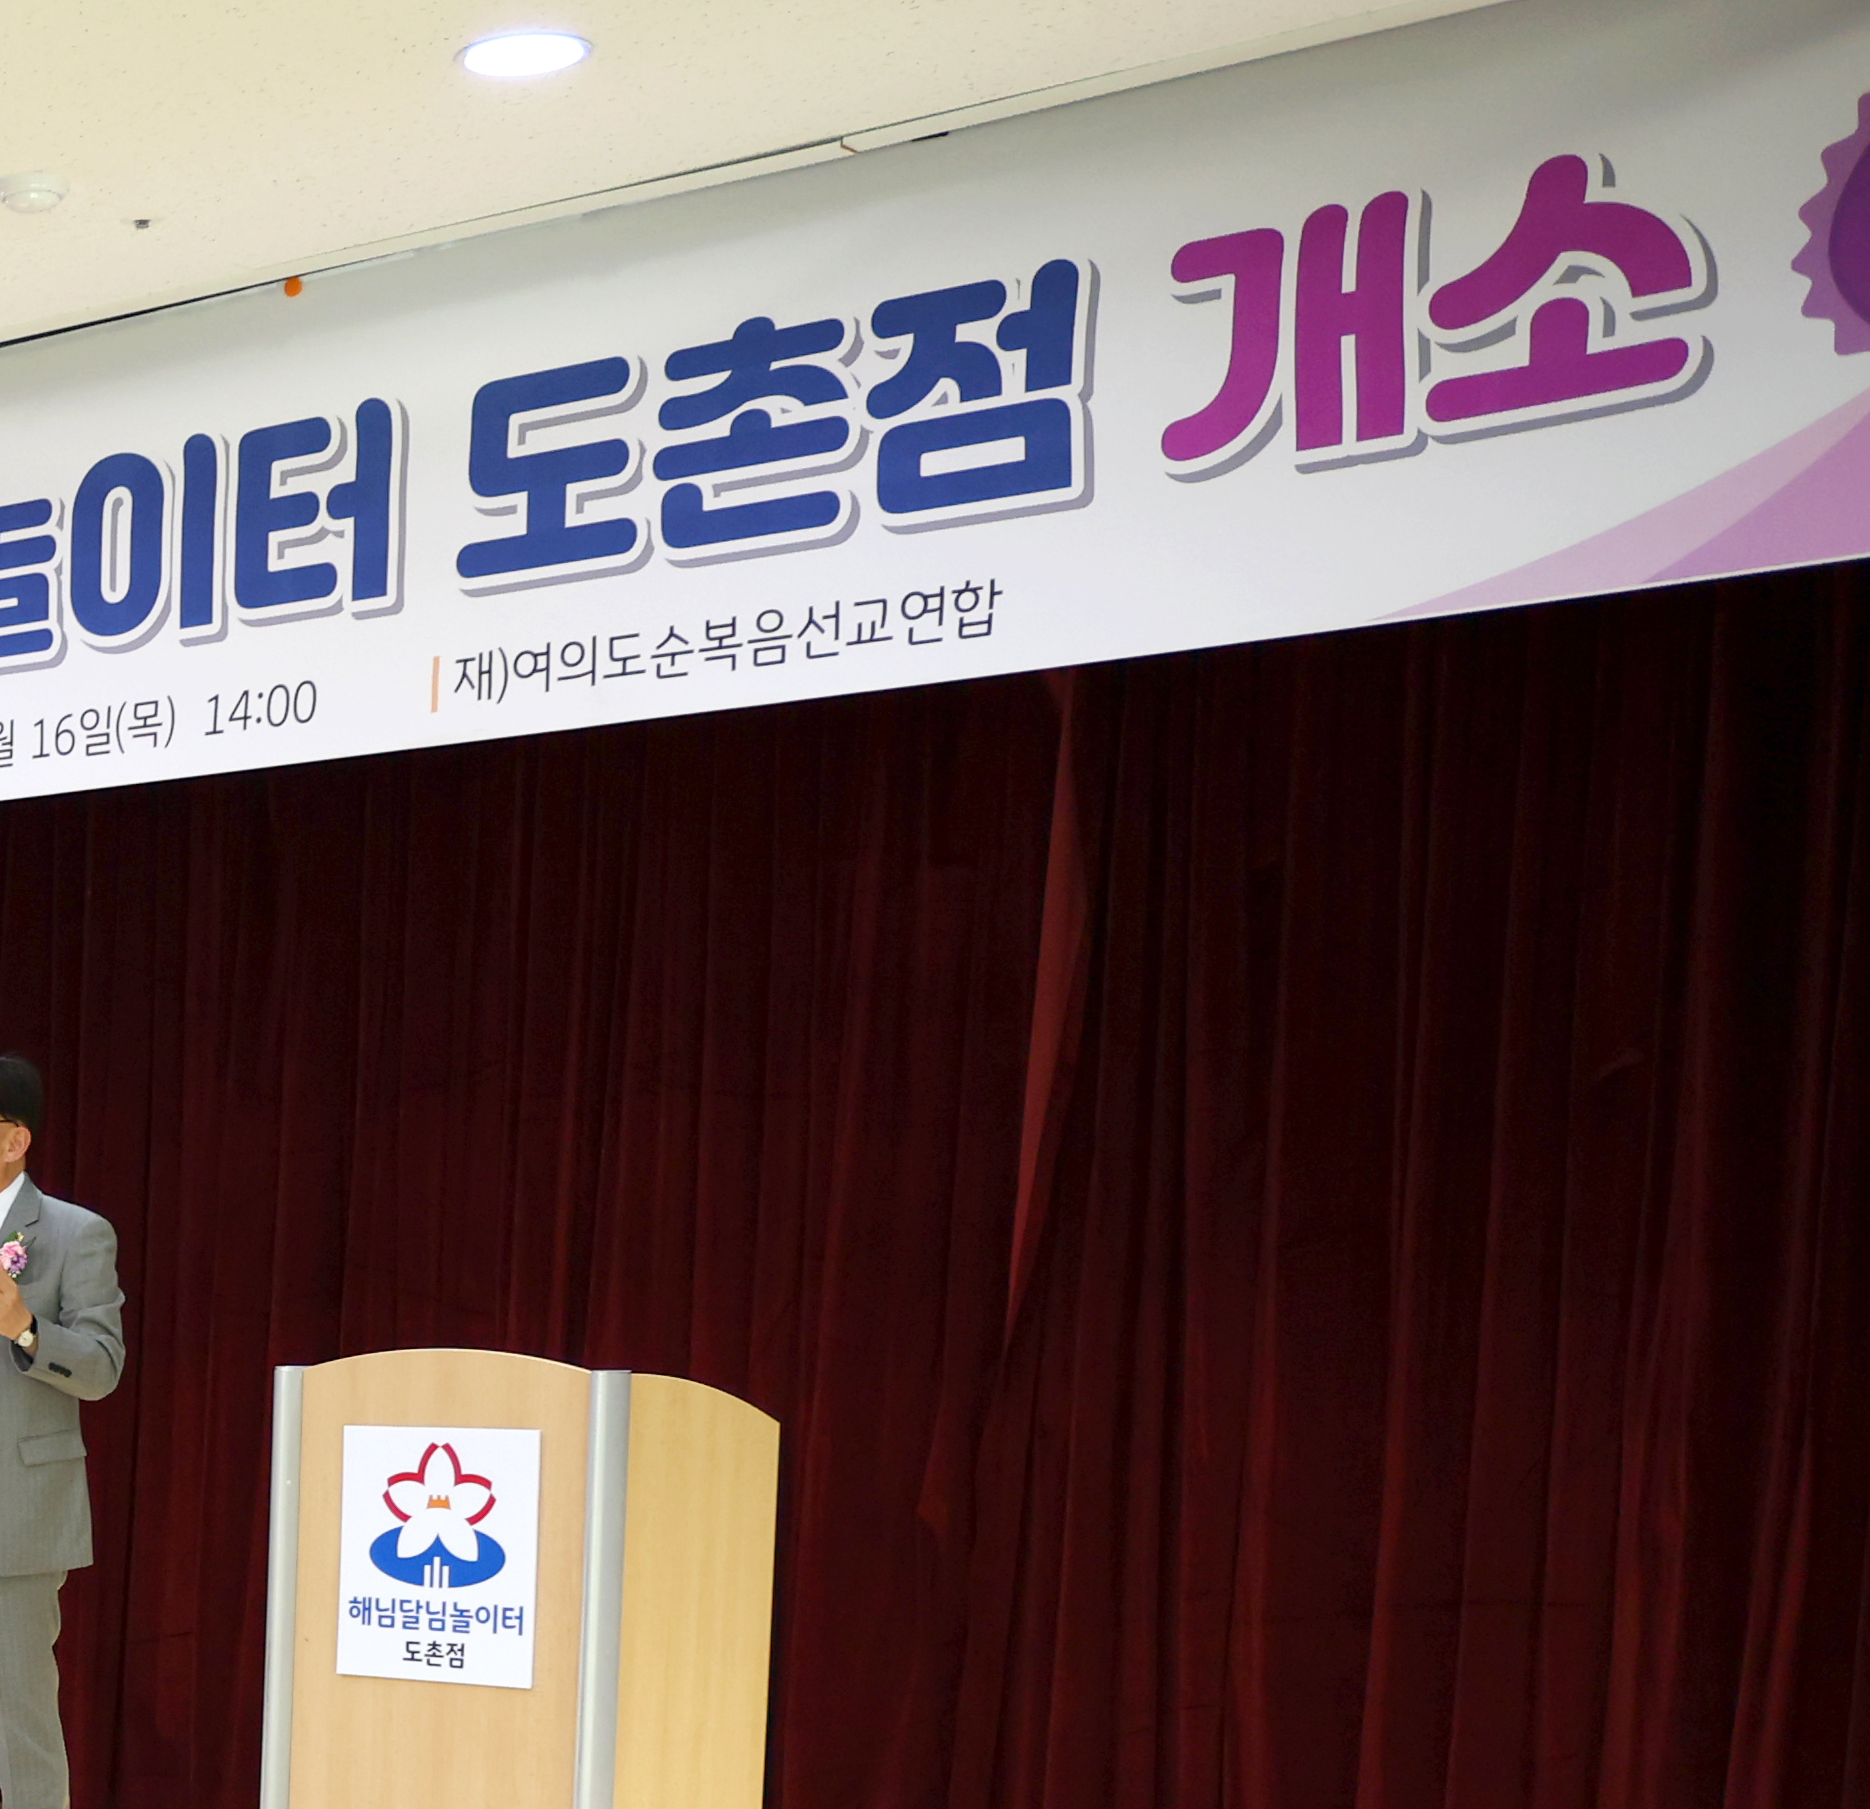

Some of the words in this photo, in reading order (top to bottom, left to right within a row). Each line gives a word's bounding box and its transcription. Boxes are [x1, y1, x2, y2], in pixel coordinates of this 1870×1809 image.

[455, 257, 1081, 579] 도촌점
[1160, 153, 1694, 462] 개소
[452, 577, 1004, 705] 재)여의도순복음선교연합
[30, 694, 177, 760] 16일(목)
[203, 679, 318, 737] 14:00
[348, 1596, 524, 1636] 해님달님놀이터
[401, 1639, 466, 1670] 도촌점
